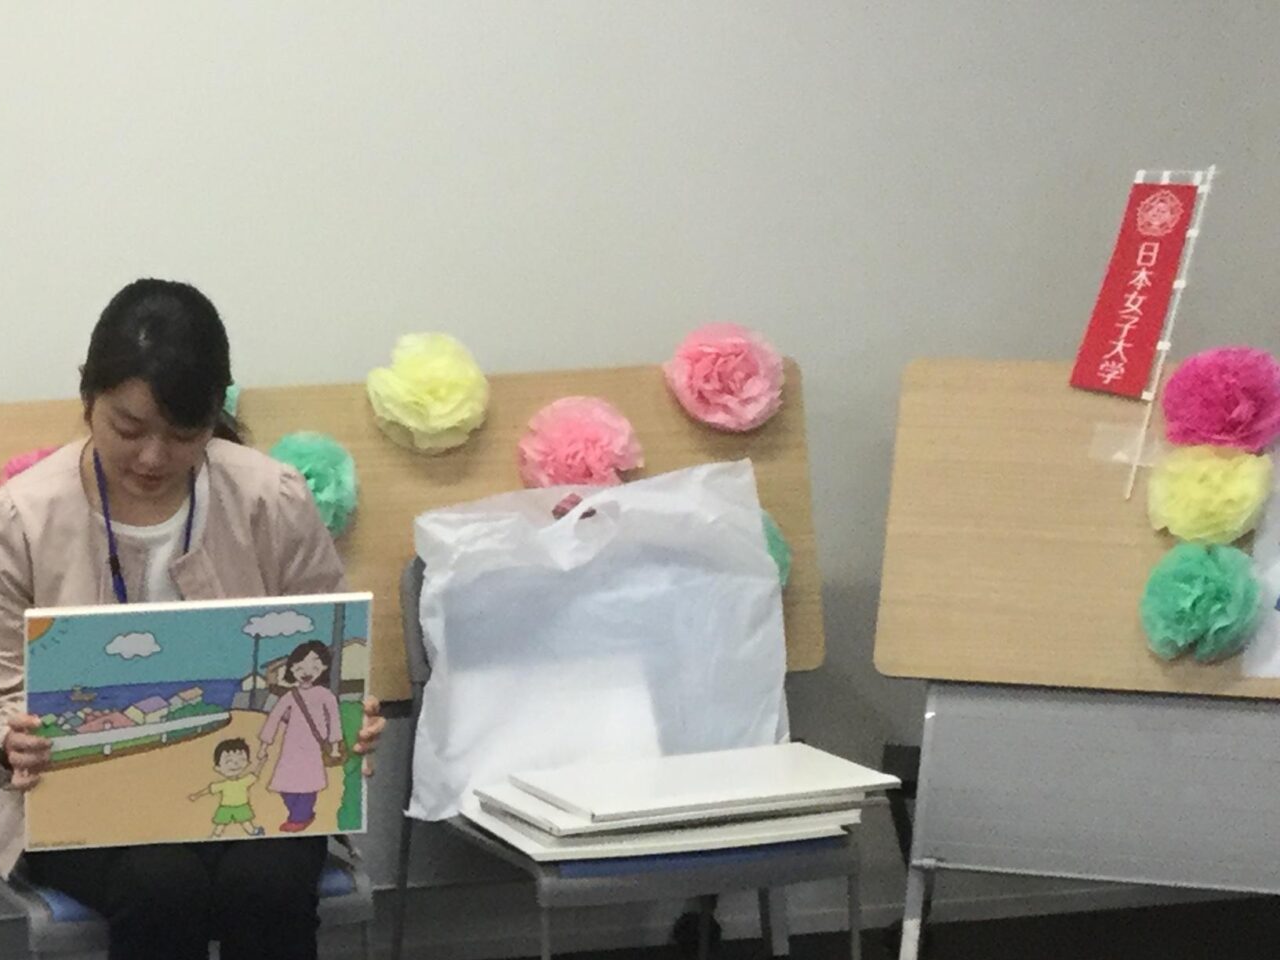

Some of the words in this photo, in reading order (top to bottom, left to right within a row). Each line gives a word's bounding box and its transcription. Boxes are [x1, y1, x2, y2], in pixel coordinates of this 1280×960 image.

[1097, 242, 1160, 384] 日本女子大学
